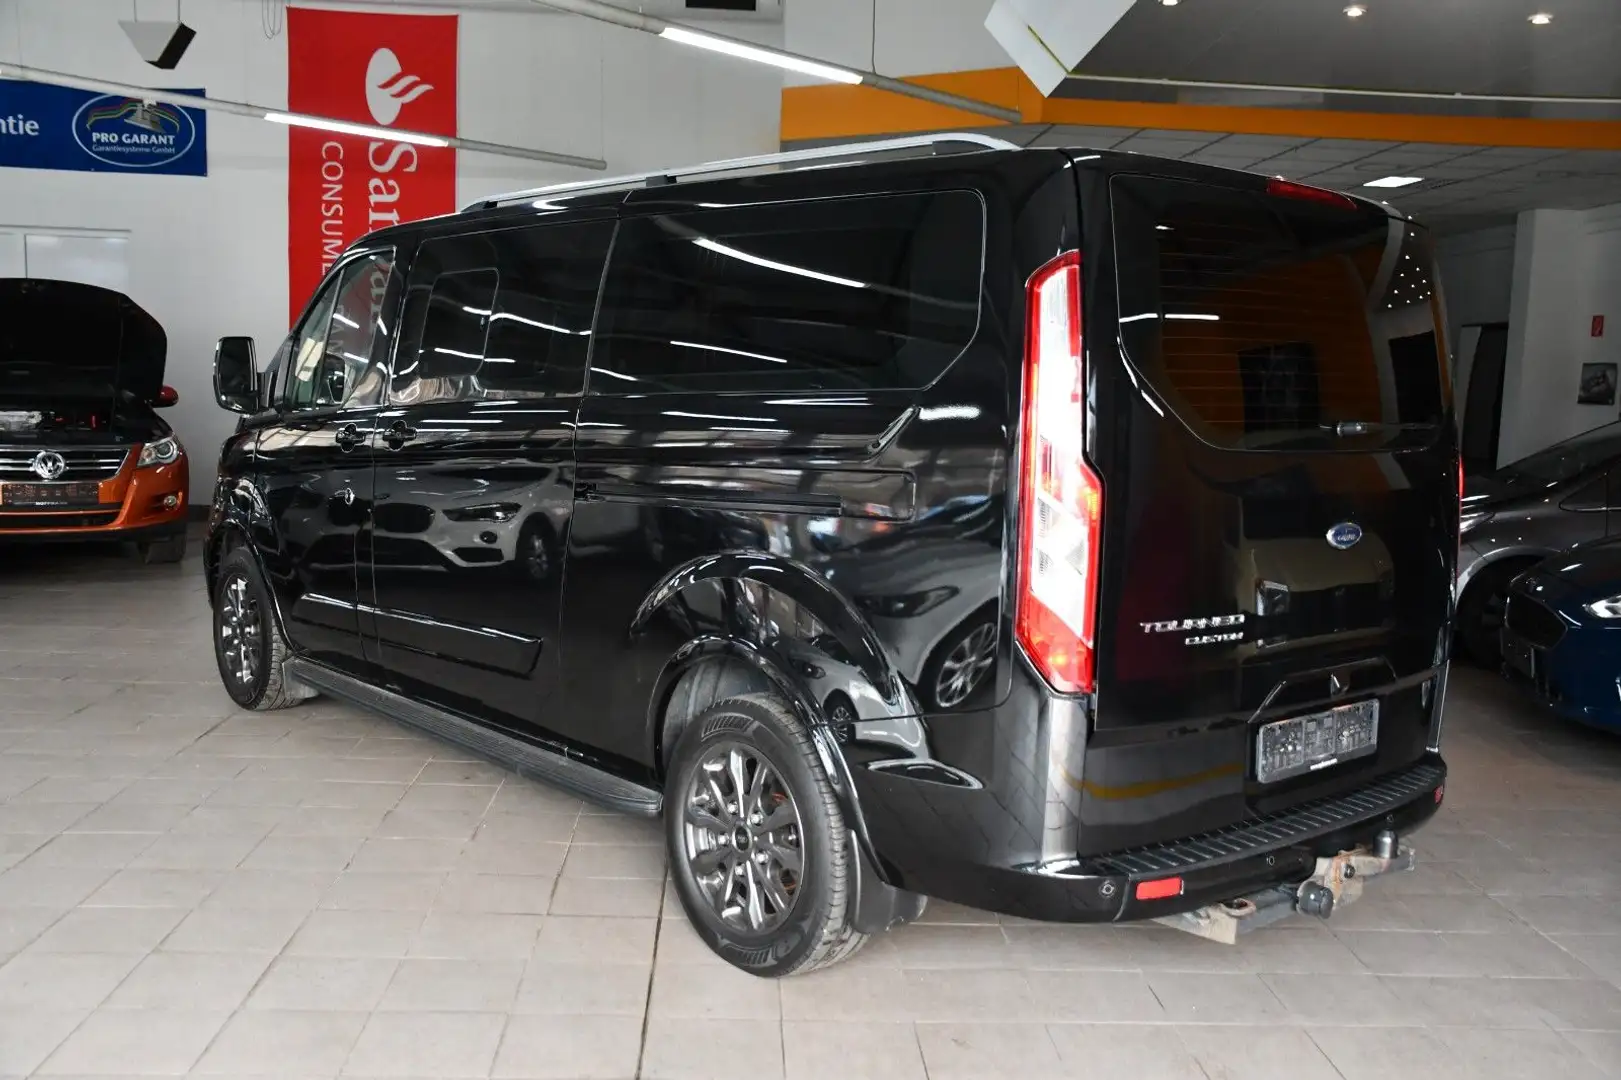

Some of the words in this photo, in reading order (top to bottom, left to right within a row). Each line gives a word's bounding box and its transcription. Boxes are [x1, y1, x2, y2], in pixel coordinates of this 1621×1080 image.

[92, 132, 119, 143] PRO
[121, 133, 176, 145] GARANT
[321, 141, 344, 277] CONSUME
